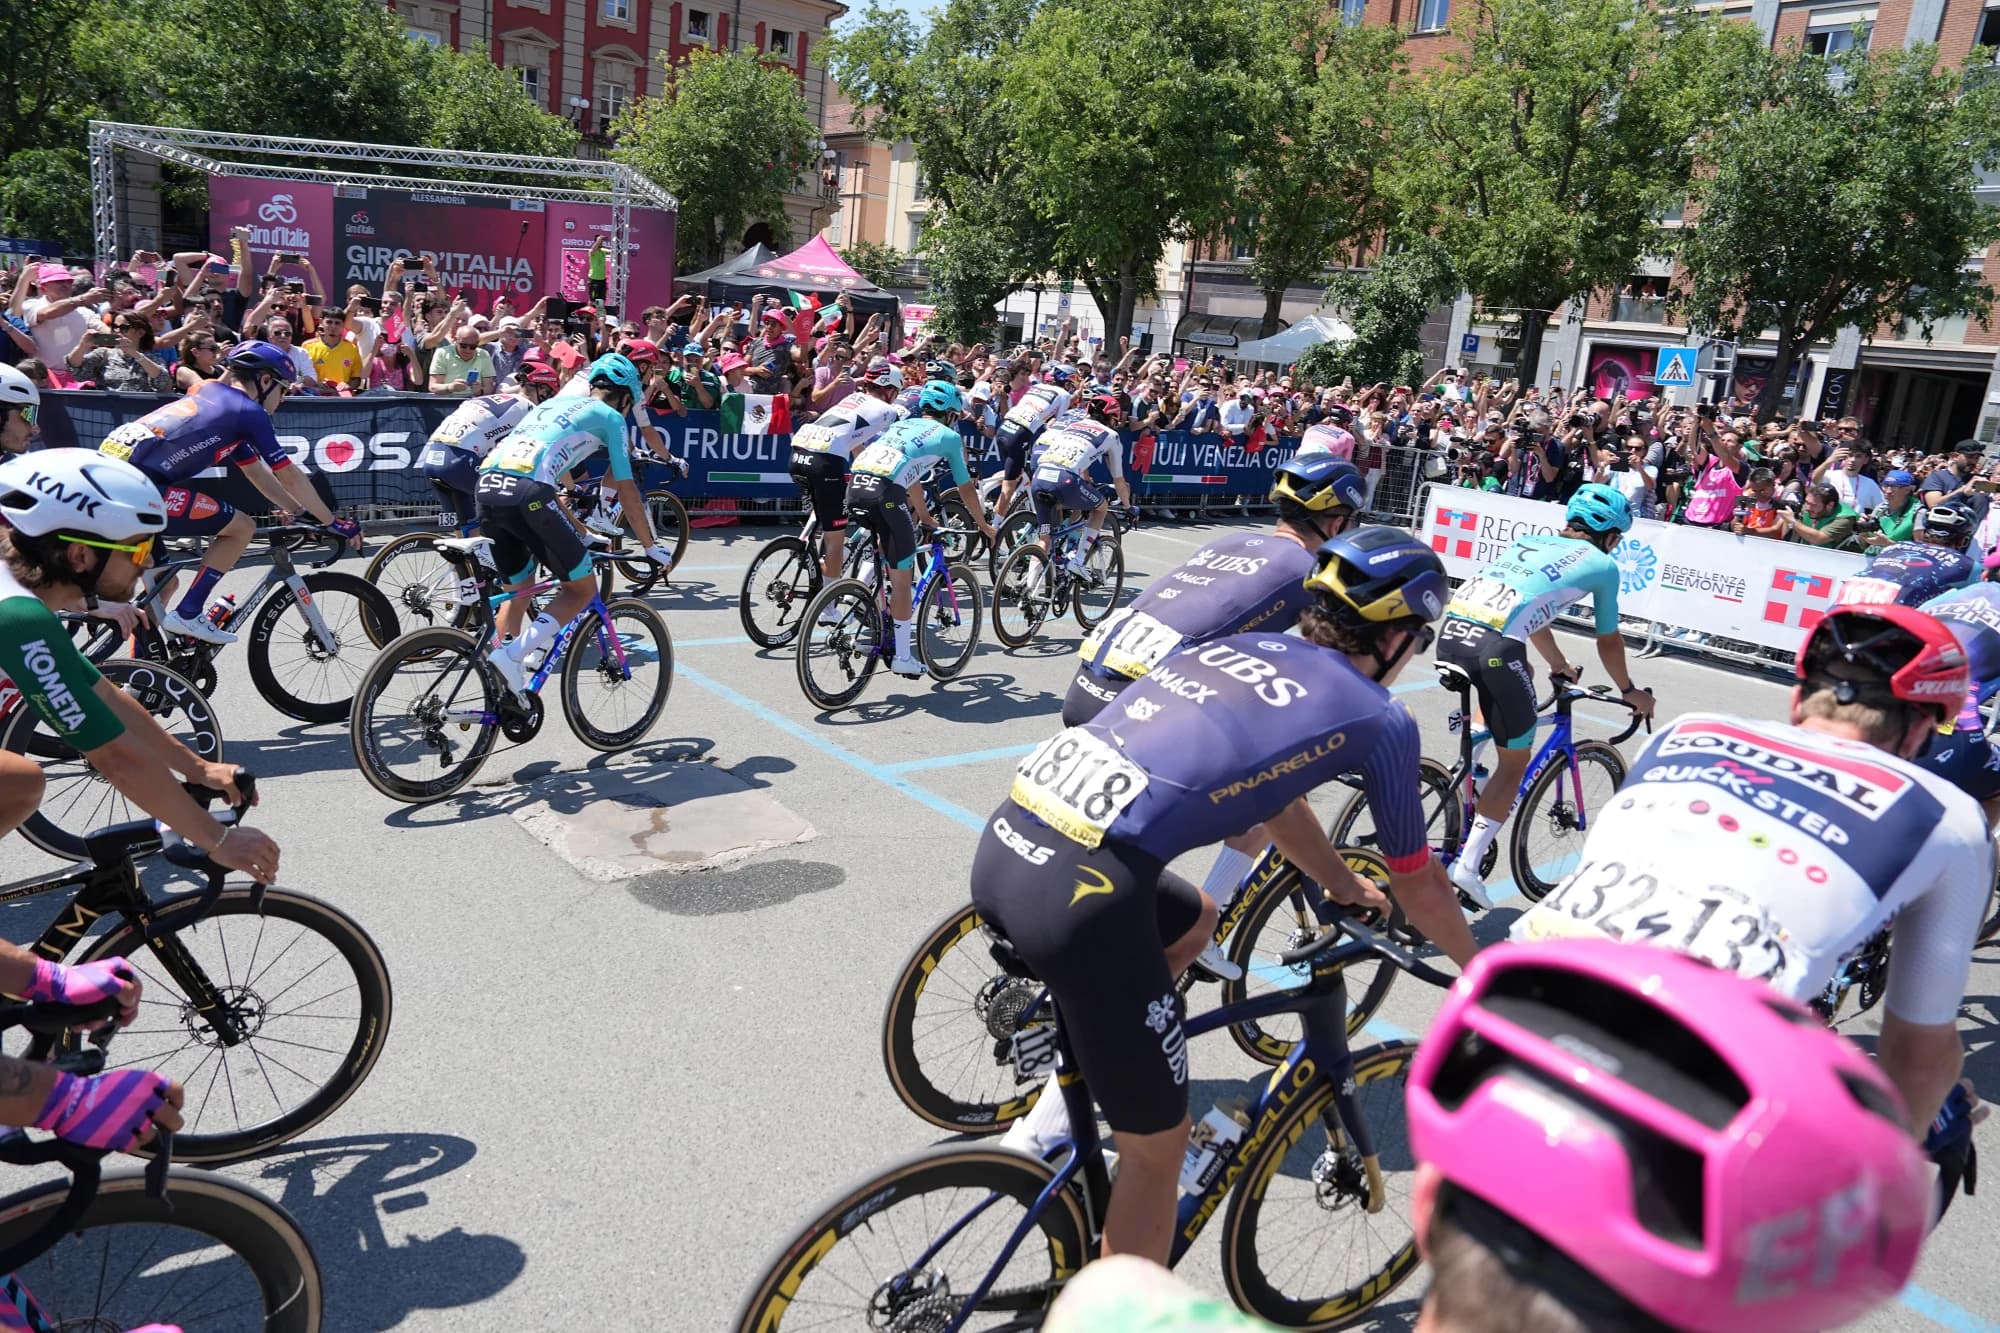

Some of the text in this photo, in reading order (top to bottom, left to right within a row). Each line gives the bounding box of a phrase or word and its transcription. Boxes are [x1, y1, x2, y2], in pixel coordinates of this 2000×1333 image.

[411, 194, 466, 205] ALESSANDRIA
[271, 226, 309, 248] d'Italia
[1465, 336, 1477, 349] P
[484, 423, 513, 441] SOUDAL
[683, 427, 779, 461] FRIULI
[167, 434, 222, 466] HANS ANDERS
[876, 449, 896, 466] 23
[1192, 443, 1262, 468] VENEZIA
[479, 473, 517, 491] CSF
[852, 474, 881, 488] CSF
[26, 471, 103, 519] KASK
[439, 514, 456, 526] 136
[1205, 553, 1269, 576] UBS
[1664, 563, 1747, 587] ECCELLENZA
[460, 581, 478, 598] 27
[1171, 571, 1216, 586] AMACX
[1661, 573, 1746, 599] PIEMONTE
[1484, 582, 1517, 611] 26
[1238, 599, 1287, 634] RELLO
[1443, 619, 1486, 640] CSF
[544, 610, 591, 675] DE ROSA
[20, 639, 87, 731] KOMETA
[1150, 665, 1219, 705] AMACX
[1197, 642, 1308, 708] UBS
[1076, 675, 1118, 702] Q36.5
[1447, 713, 1461, 732] 26
[1208, 731, 1347, 804] PINARELLO
[1525, 749, 1557, 792] ROSA
[1662, 730, 1882, 813] SOUDAL
[1544, 860, 1660, 942] 132
[1015, 1026, 1056, 1073] 118
[1183, 1058, 1316, 1242] PINARELLO
